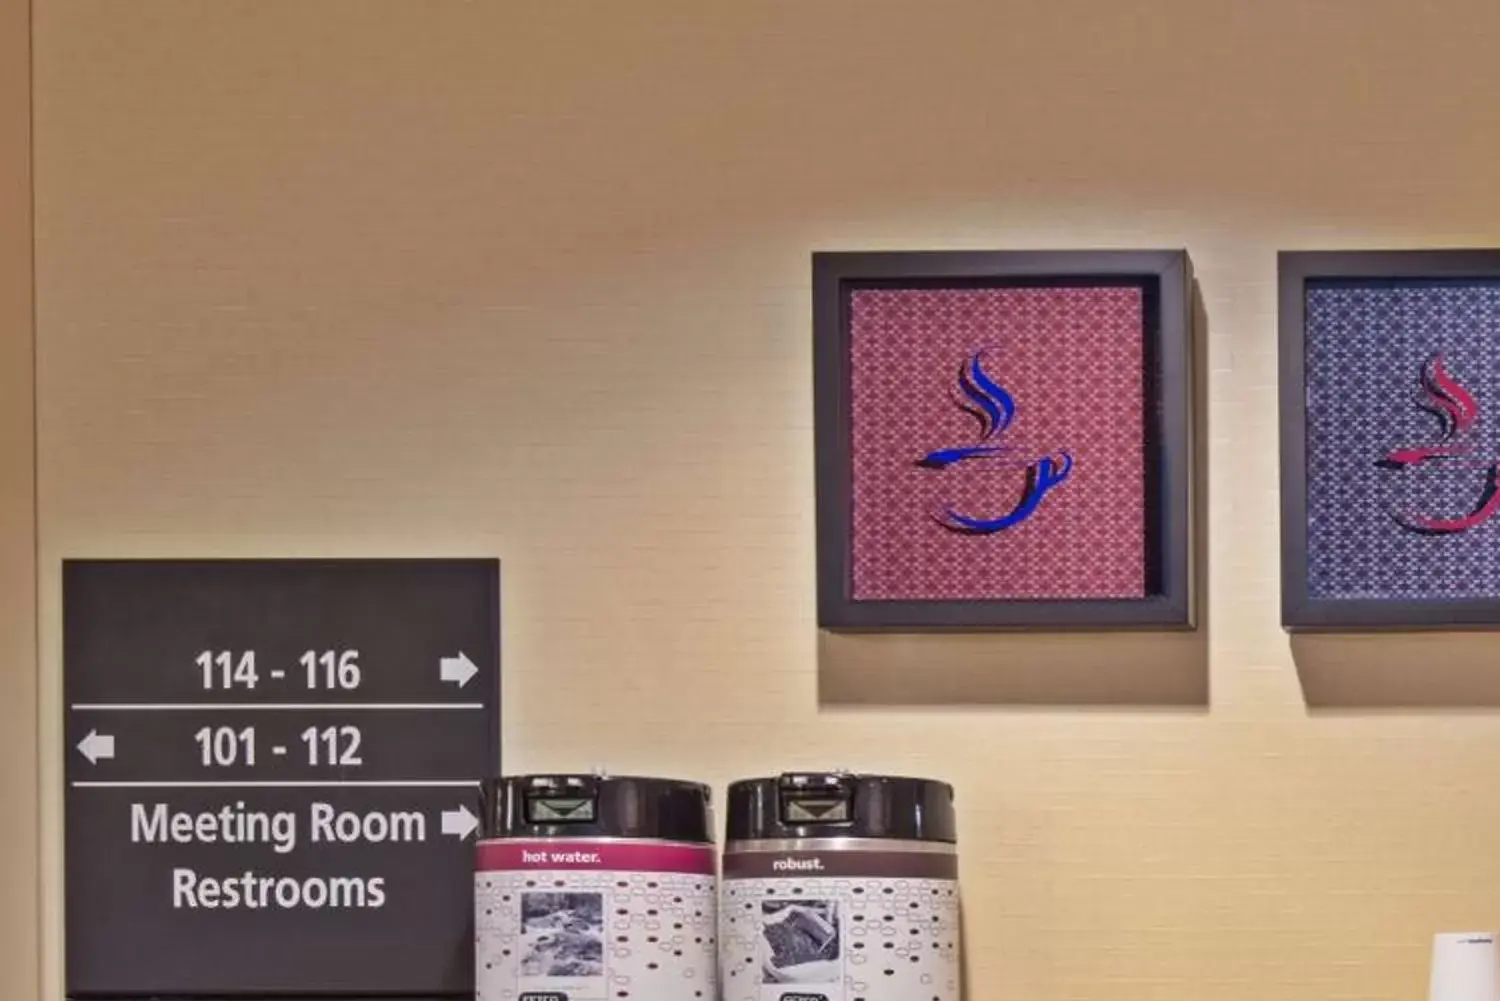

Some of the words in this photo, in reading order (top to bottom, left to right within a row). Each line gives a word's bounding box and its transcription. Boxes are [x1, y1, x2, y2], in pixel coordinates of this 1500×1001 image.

[196, 651, 258, 689] 114
[300, 650, 361, 689] 116
[195, 727, 256, 765] 101
[301, 727, 362, 765] 112
[130, 801, 297, 854] Meeting
[311, 802, 426, 841] Room
[522, 849, 547, 863] hot
[172, 868, 386, 908] Restrooms
